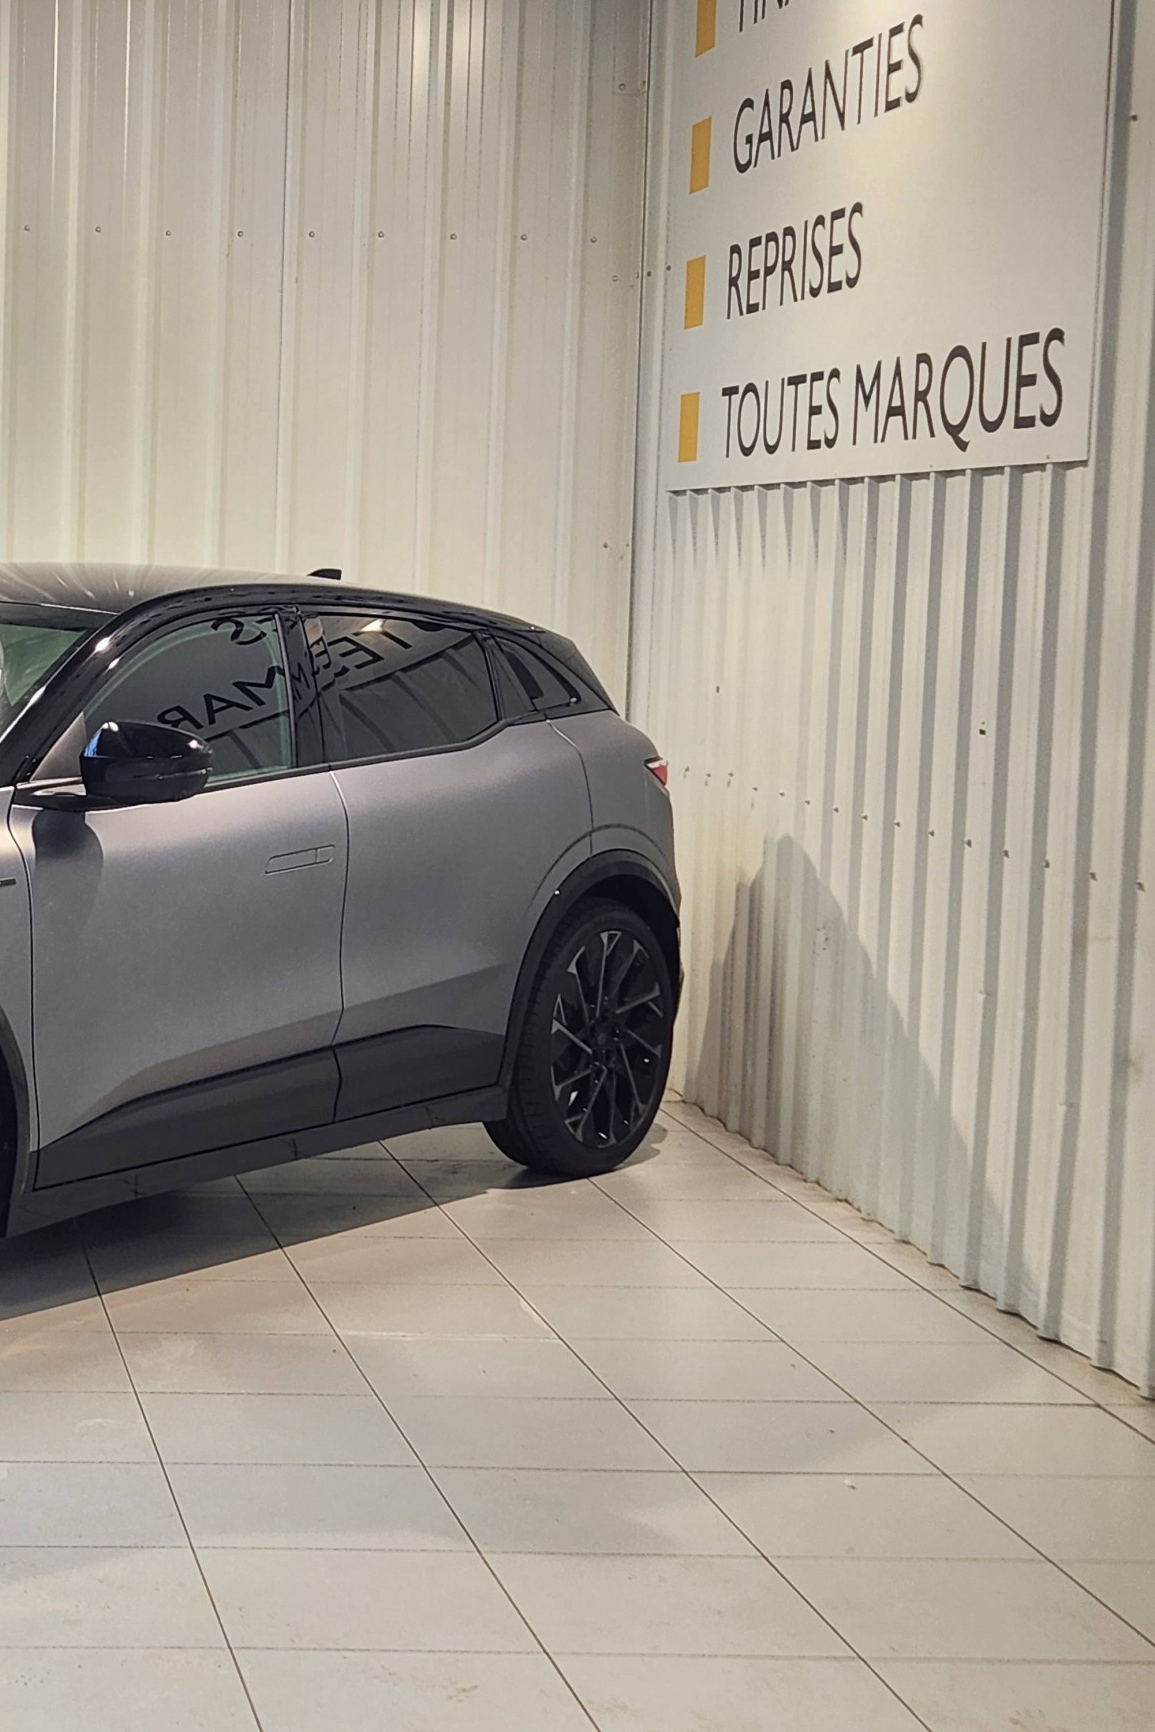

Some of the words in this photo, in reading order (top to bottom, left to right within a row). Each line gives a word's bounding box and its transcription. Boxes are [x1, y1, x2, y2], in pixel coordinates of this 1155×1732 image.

[733, 14, 923, 174] GARANTIES
[727, 202, 863, 320] REPRISES
[722, 367, 841, 459] TOUTES
[852, 327, 1065, 453] MARQUES
